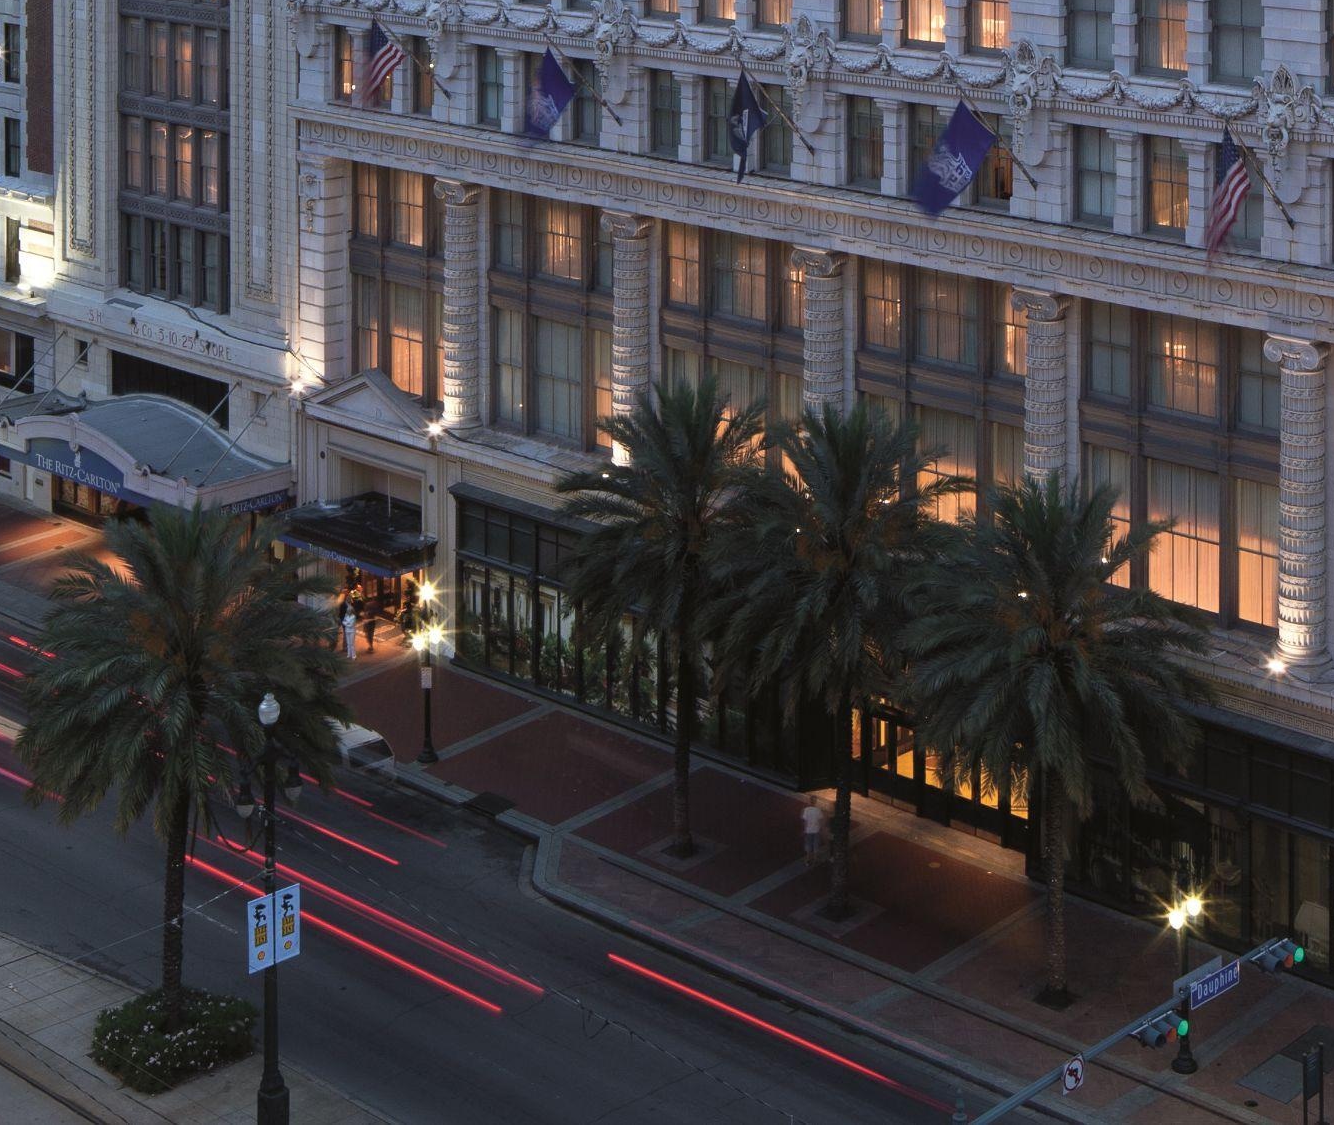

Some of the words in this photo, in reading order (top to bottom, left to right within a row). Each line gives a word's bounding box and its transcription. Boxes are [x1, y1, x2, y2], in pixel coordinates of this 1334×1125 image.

[200, 339, 232, 361] STORE
[35, 453, 53, 471] THE
[55, 460, 119, 493] RITZ-CARLTON
[1197, 966, 1238, 1000] Dauphine
